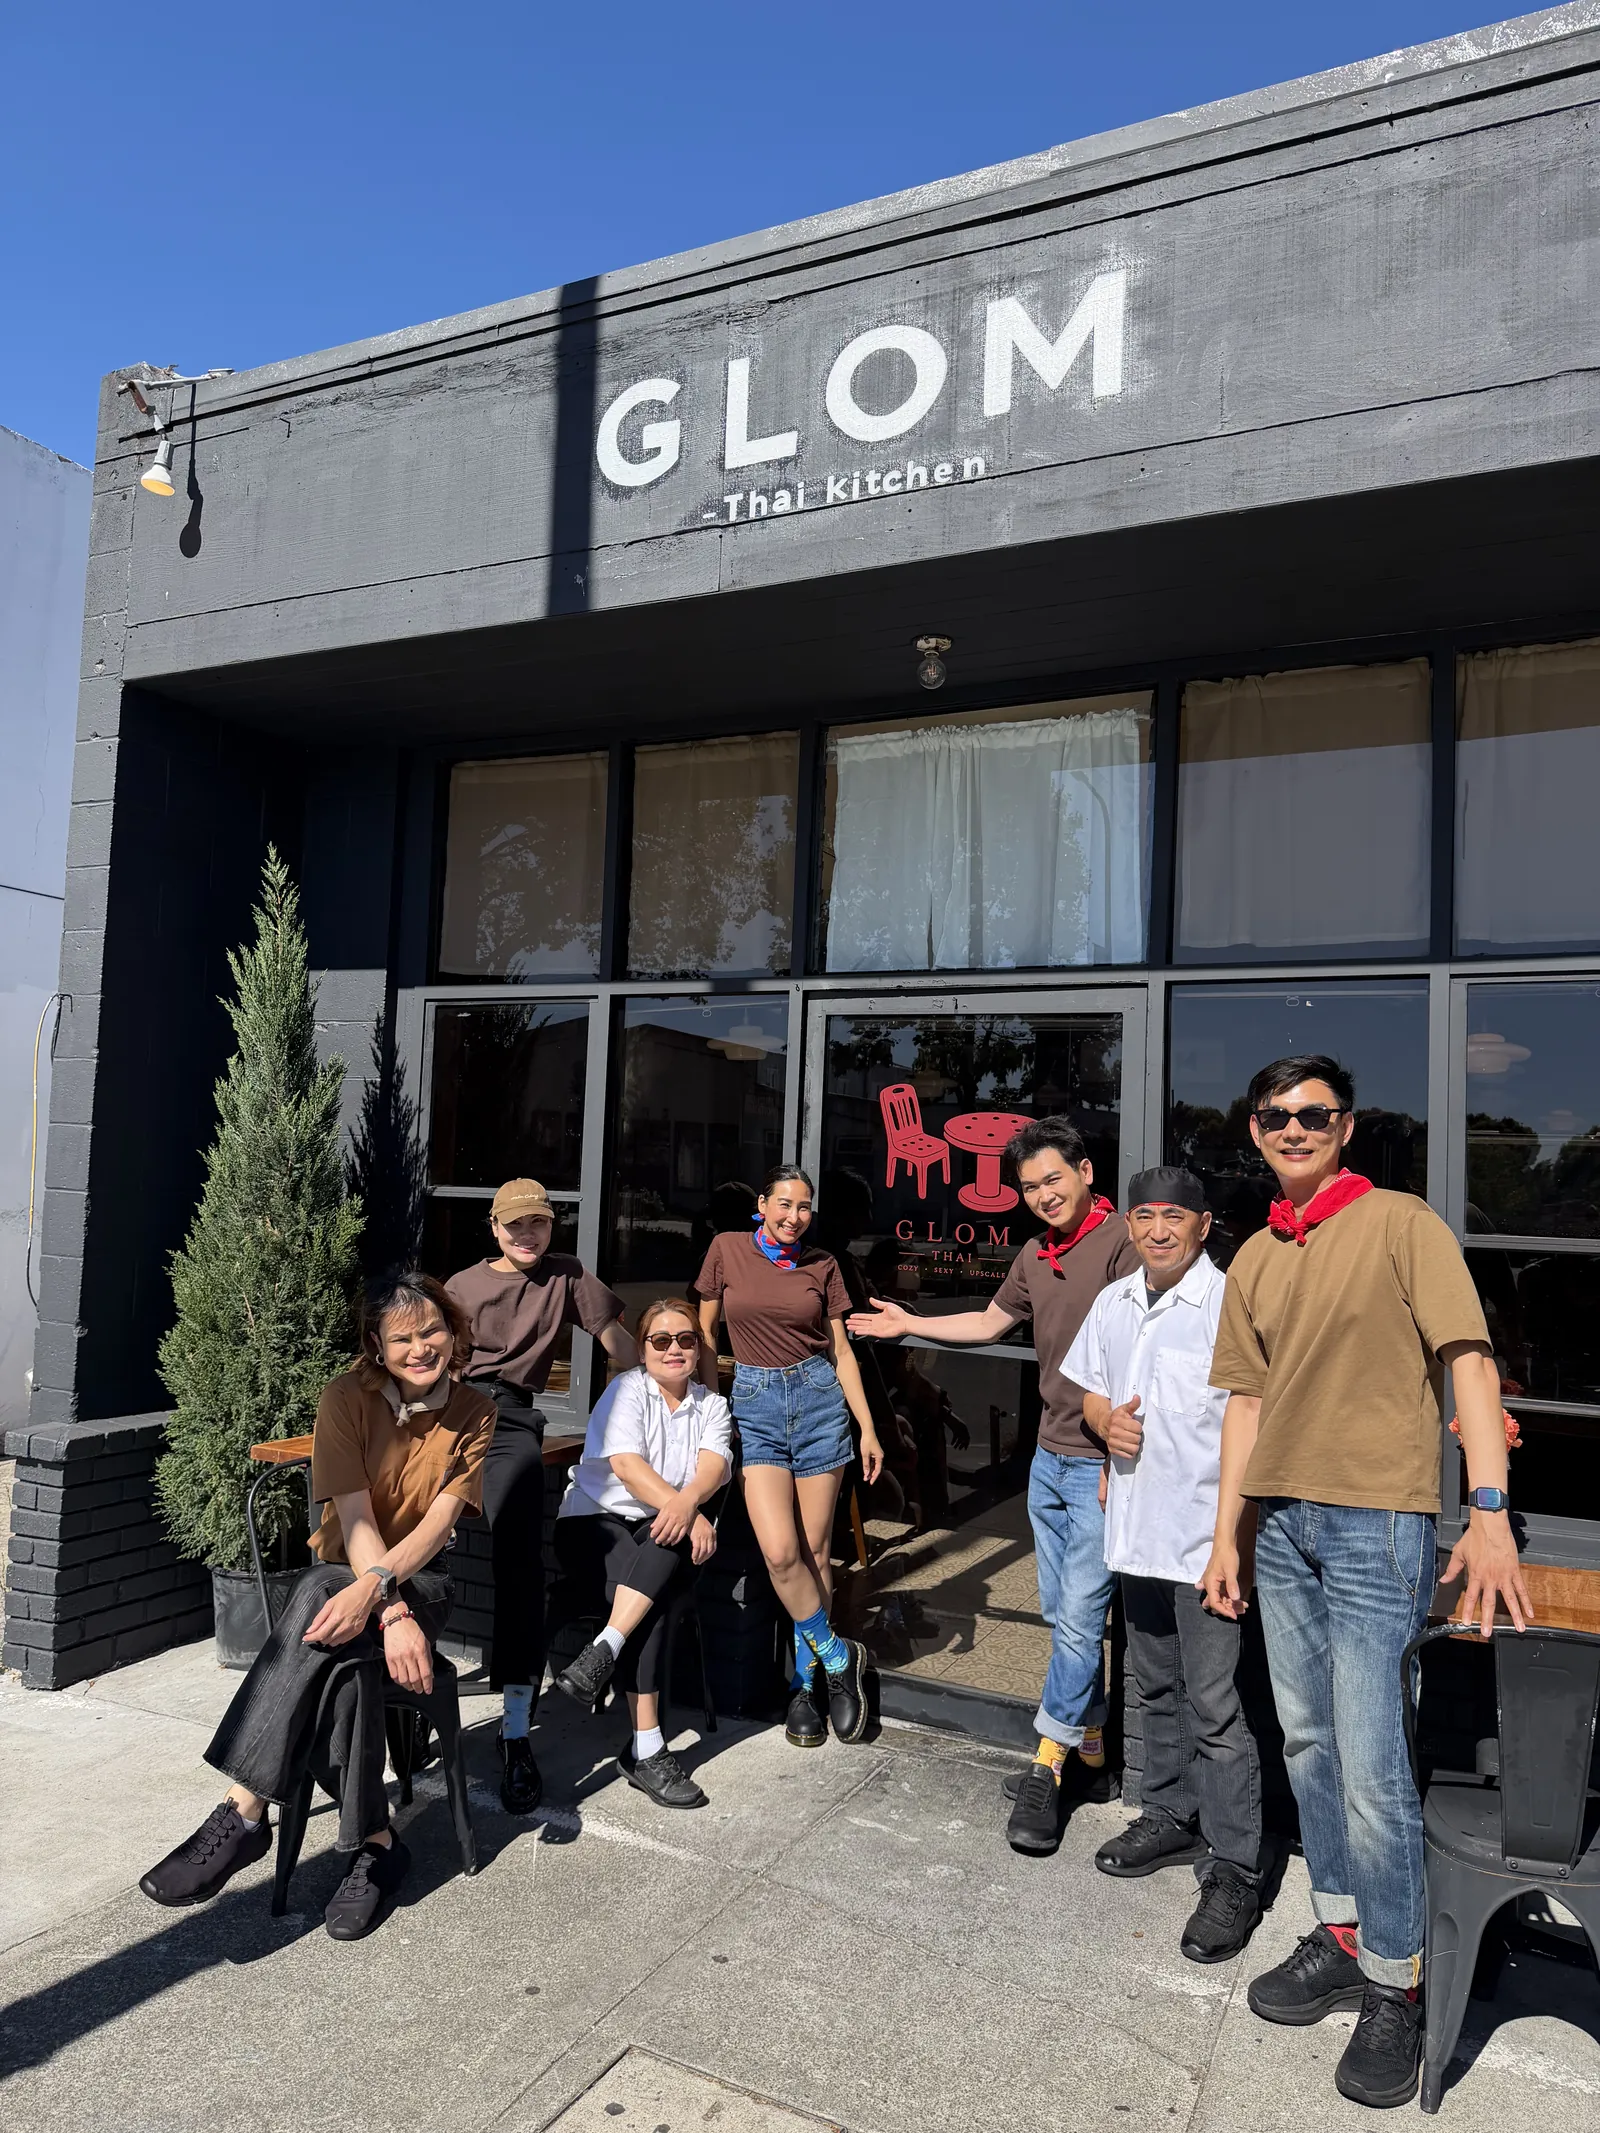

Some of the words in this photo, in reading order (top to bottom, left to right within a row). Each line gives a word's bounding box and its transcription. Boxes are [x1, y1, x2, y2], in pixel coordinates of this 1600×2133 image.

[596, 269, 1128, 487] GLOM
[826, 455, 986, 504] Kitchen
[895, 1219, 1011, 1247] GLOM
[931, 1250, 972, 1263] THAI
[897, 1264, 919, 1272] COZY
[933, 1267, 954, 1275] SEXY
[969, 1269, 1006, 1279] UPSCALE
